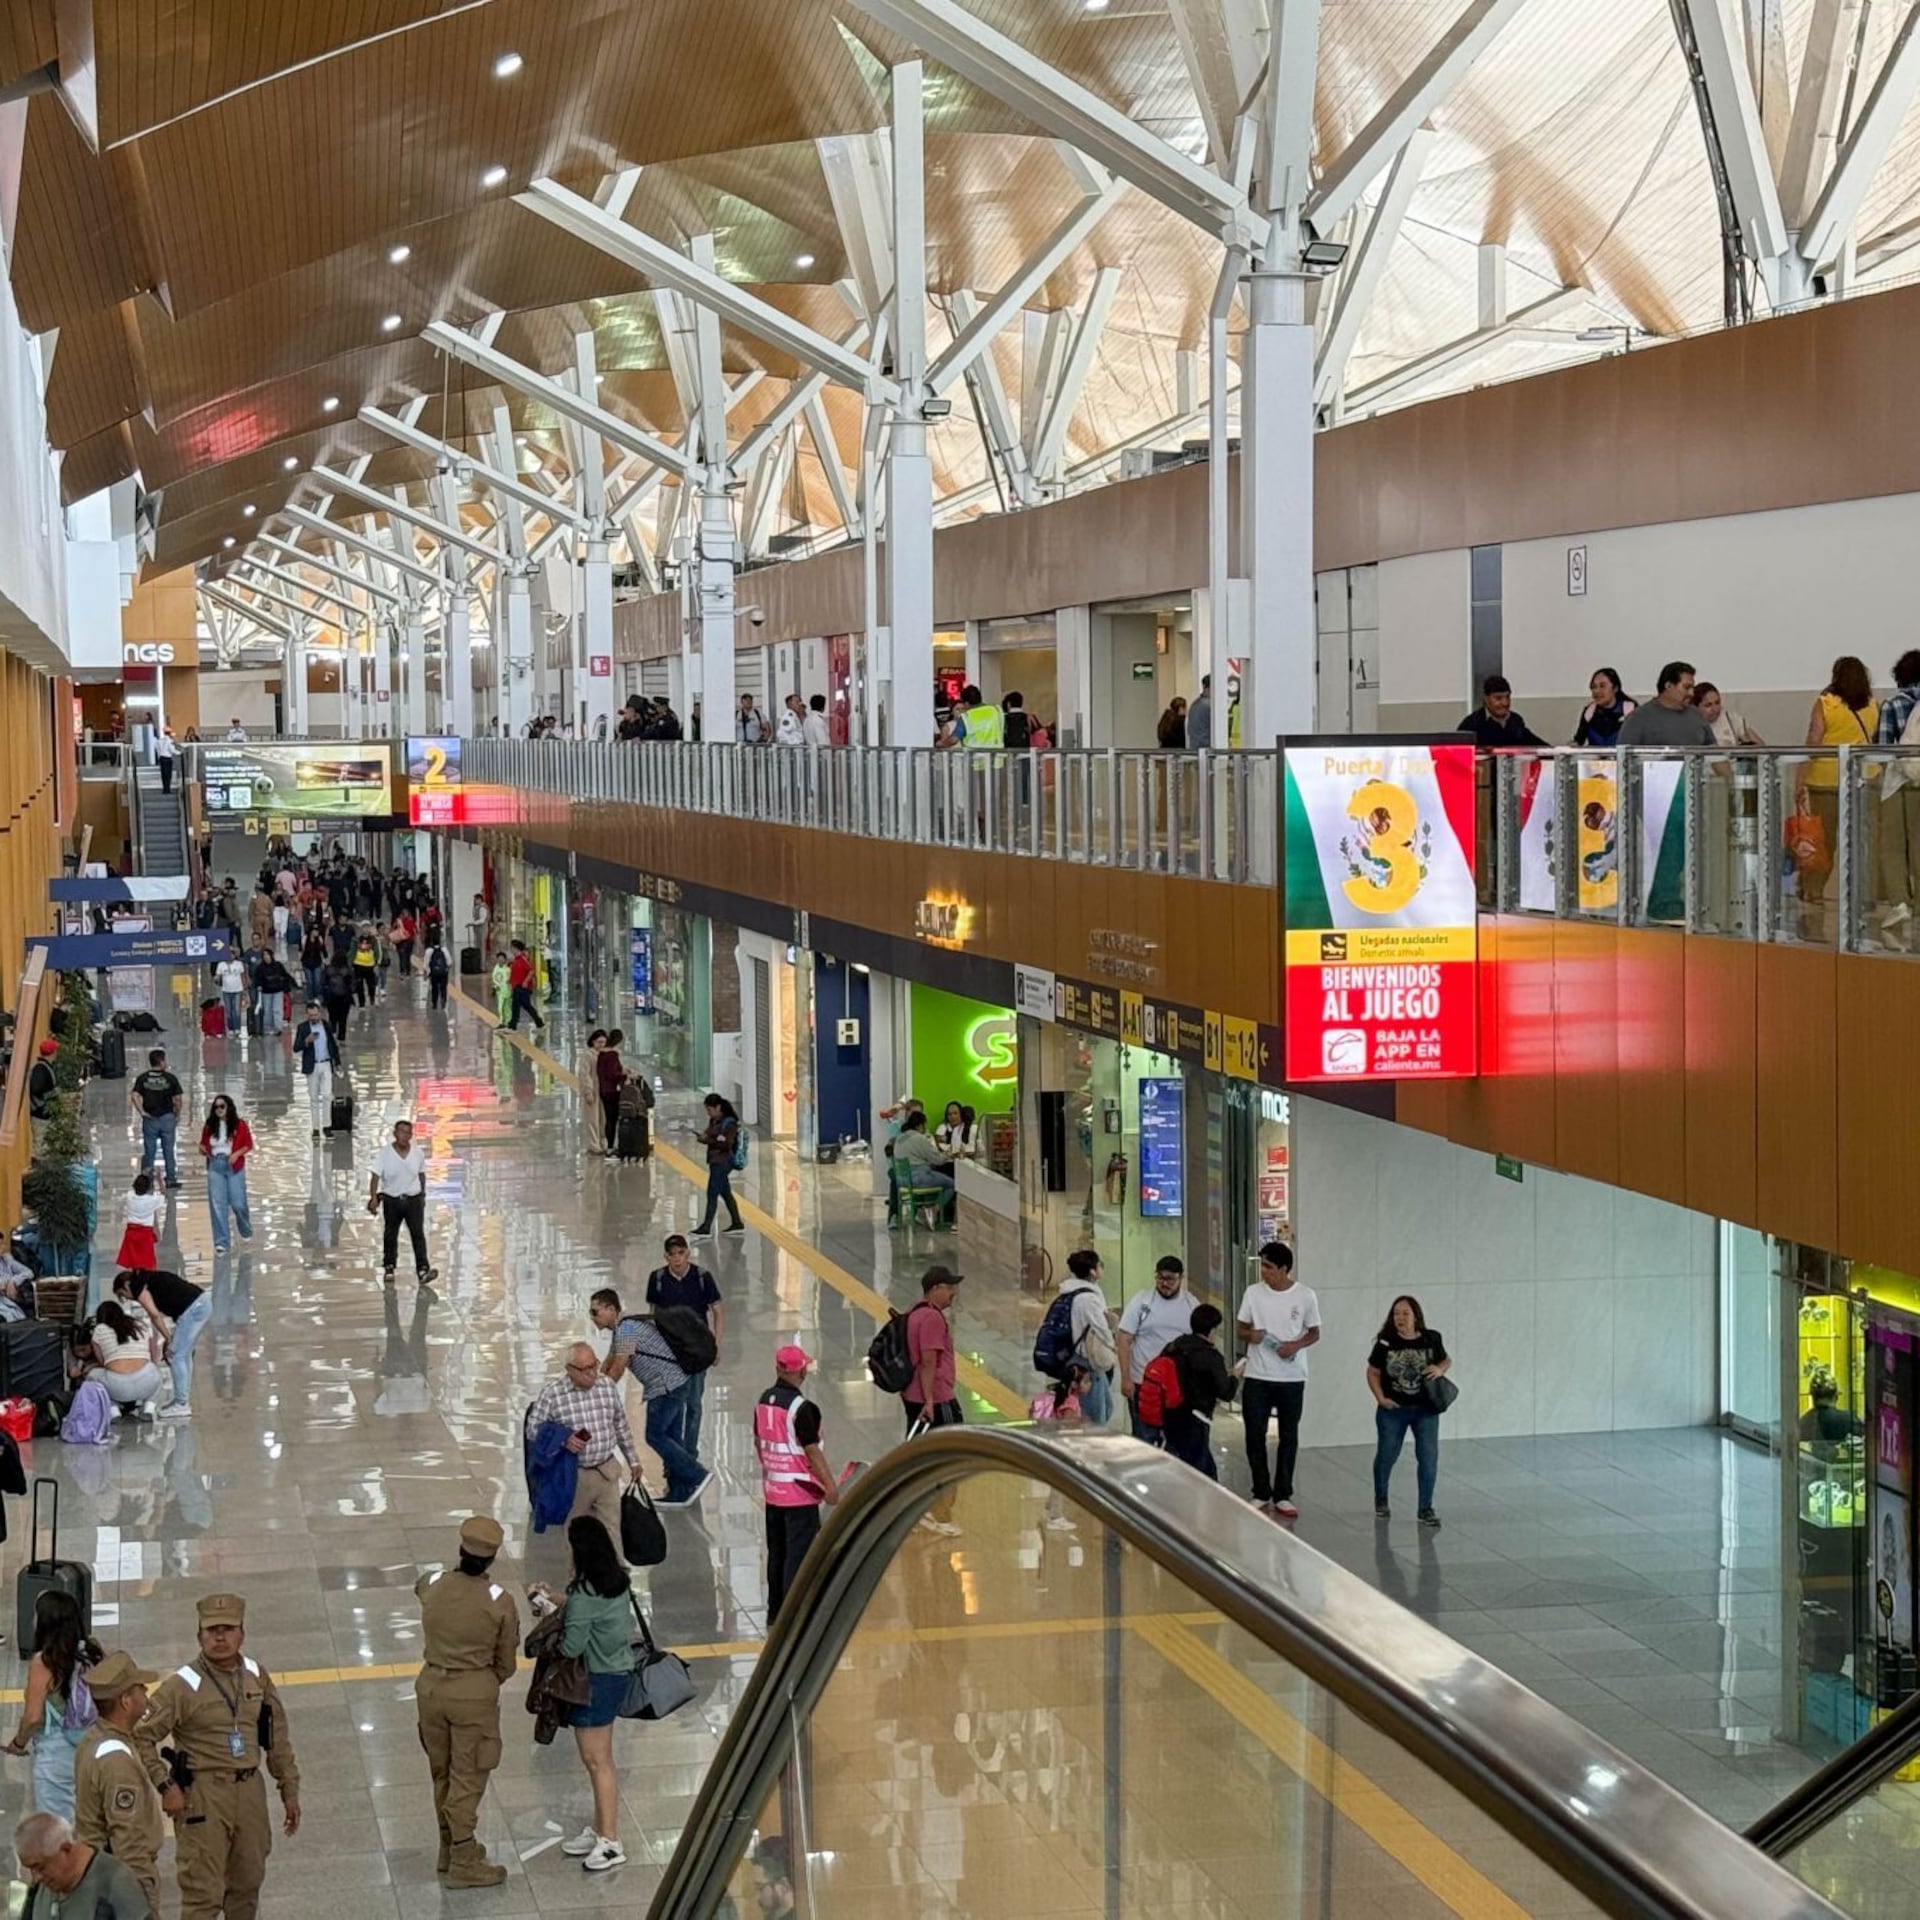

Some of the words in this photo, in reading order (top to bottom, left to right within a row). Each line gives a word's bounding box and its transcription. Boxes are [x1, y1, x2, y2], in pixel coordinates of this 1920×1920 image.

[424, 746, 447, 784] 2
[1323, 756, 1385, 775] Puerta
[1341, 782, 1421, 915] 3
[1360, 935, 1399, 948] Llegadas
[1401, 933, 1449, 945] nacionales
[1321, 964, 1442, 991] BIENVENIDOS
[1322, 990, 1353, 1021] AL
[1360, 988, 1441, 1021] JUEGO
[1206, 1022, 1219, 1061] B1
[1376, 1030, 1416, 1042] BAJA
[1420, 1029, 1440, 1042] LA
[1374, 1044, 1411, 1058] APP
[1416, 1044, 1440, 1057] EN
[1374, 1059, 1441, 1071] caliente.mx
